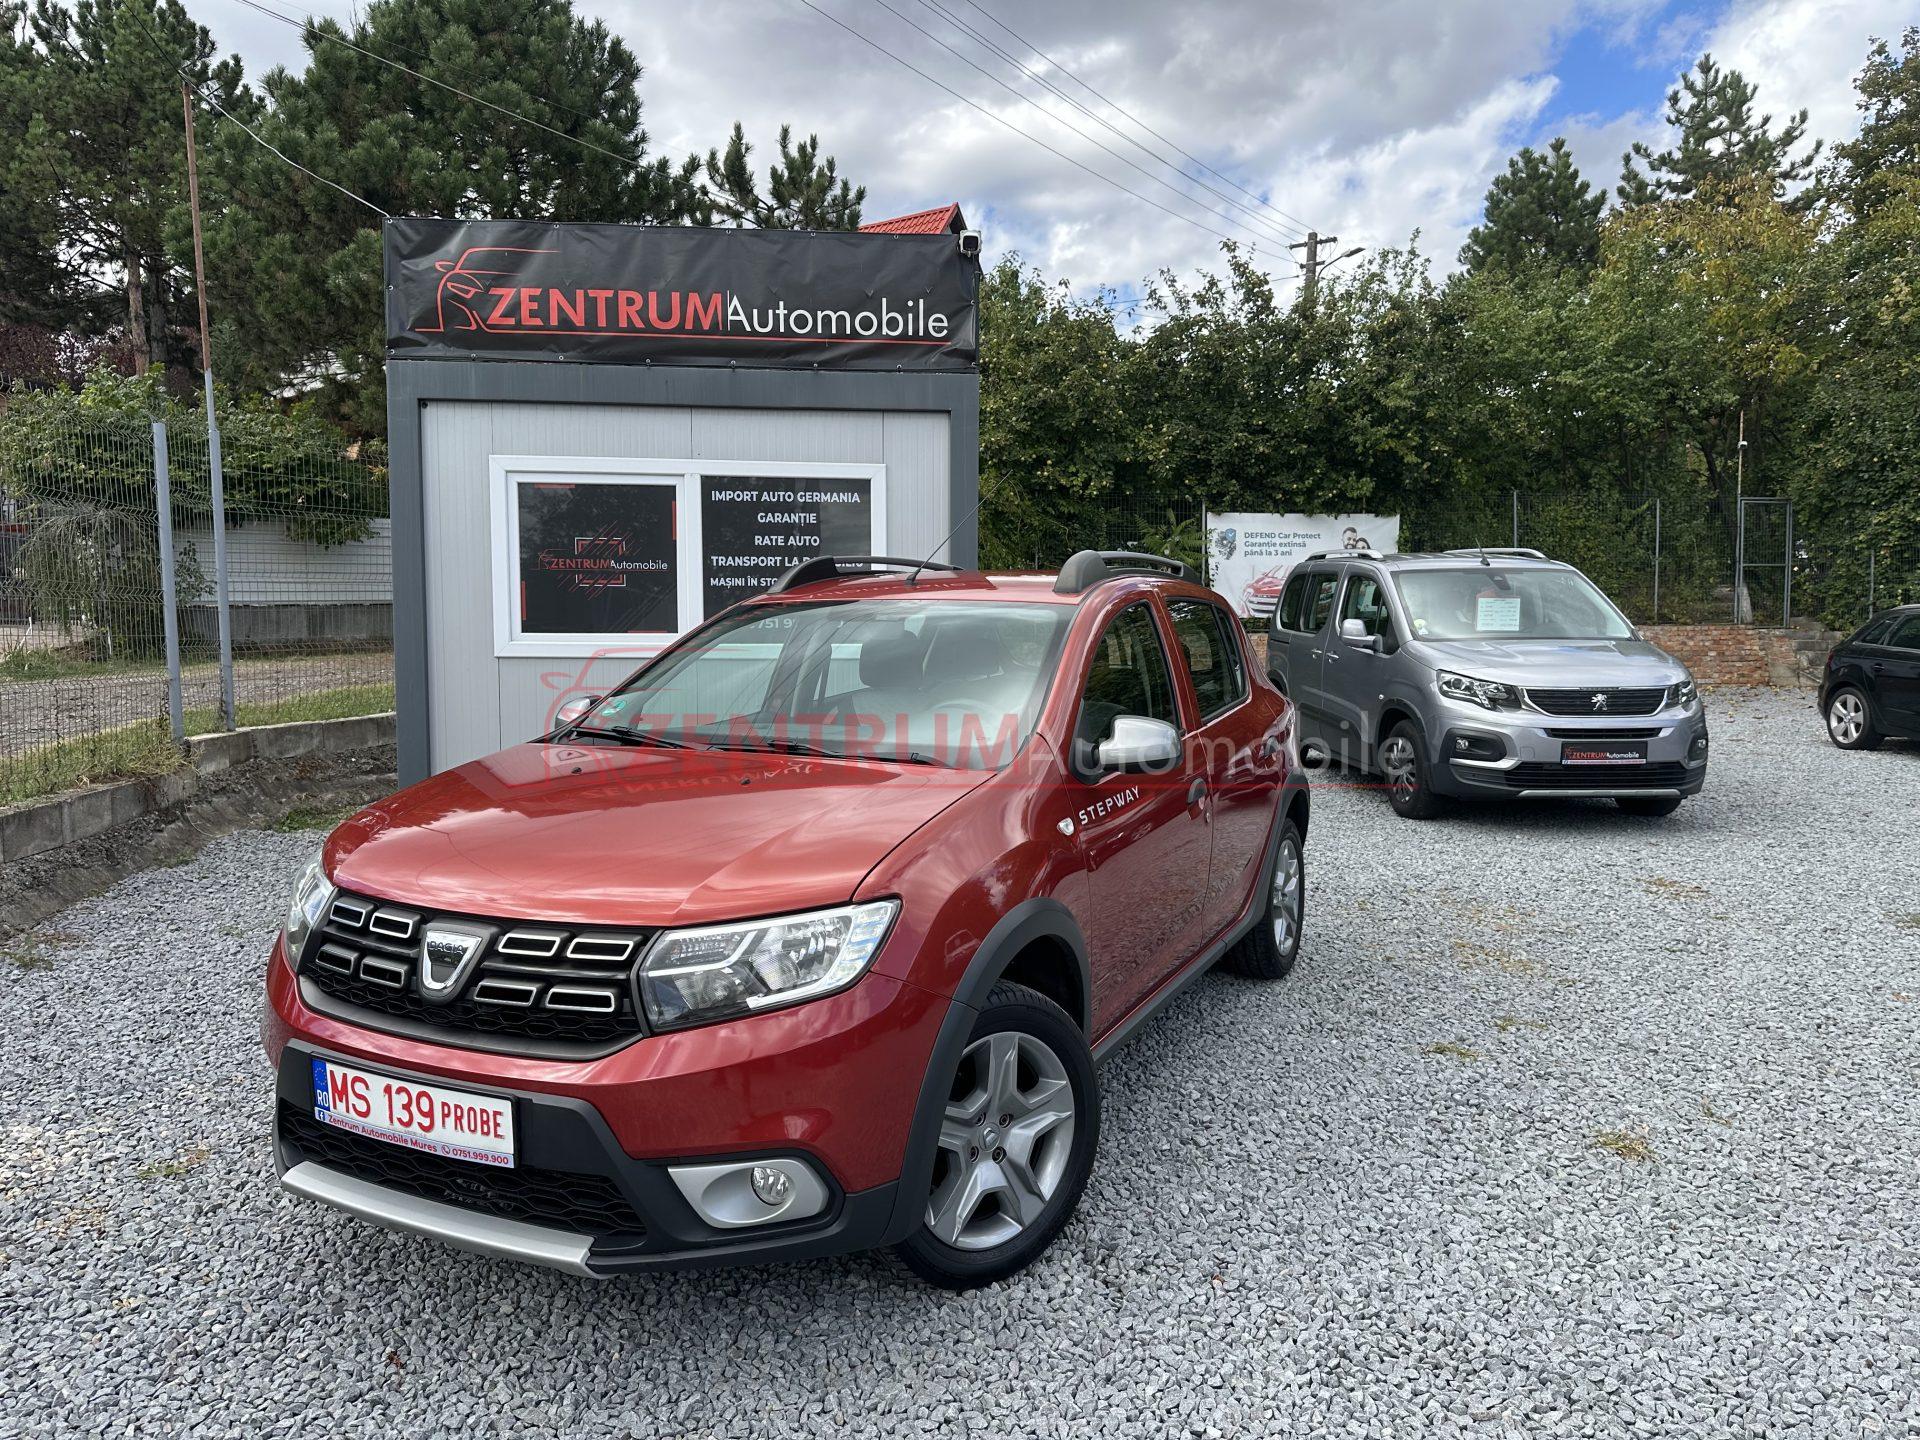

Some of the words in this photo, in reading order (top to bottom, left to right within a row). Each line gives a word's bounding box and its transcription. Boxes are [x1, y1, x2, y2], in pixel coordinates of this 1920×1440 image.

[487, 287, 724, 332] ZENTRUM
[727, 290, 948, 337] Automobile
[711, 491, 758, 501] IMPORT
[761, 491, 794, 502] AUTO
[797, 492, 860, 503] GERMANIA
[757, 513, 817, 526] GARANȚIE
[754, 535, 785, 546] RATE
[788, 535, 820, 546] AUTO
[551, 559, 611, 569] ZENTRUM
[610, 559, 668, 570] Automobile
[711, 556, 783, 567] TRANSPORT
[785, 556, 799, 567] LA
[710, 577, 747, 590] MAȘINI
[747, 575, 758, 587] ÎN
[1606, 751, 1640, 759] Automobile
[1079, 785, 1140, 825] STEPWAY
[427, 941, 464, 955] DACIA
[316, 1090, 329, 1107] RO
[329, 1069, 371, 1119] MS
[383, 1083, 435, 1133] 139
[441, 1101, 505, 1140] PROBE
[328, 1114, 360, 1132] Zentrum
[361, 1123, 409, 1146] Automobile
[410, 1138, 438, 1153] Mures
[452, 1148, 509, 1165] 0751.999.900
